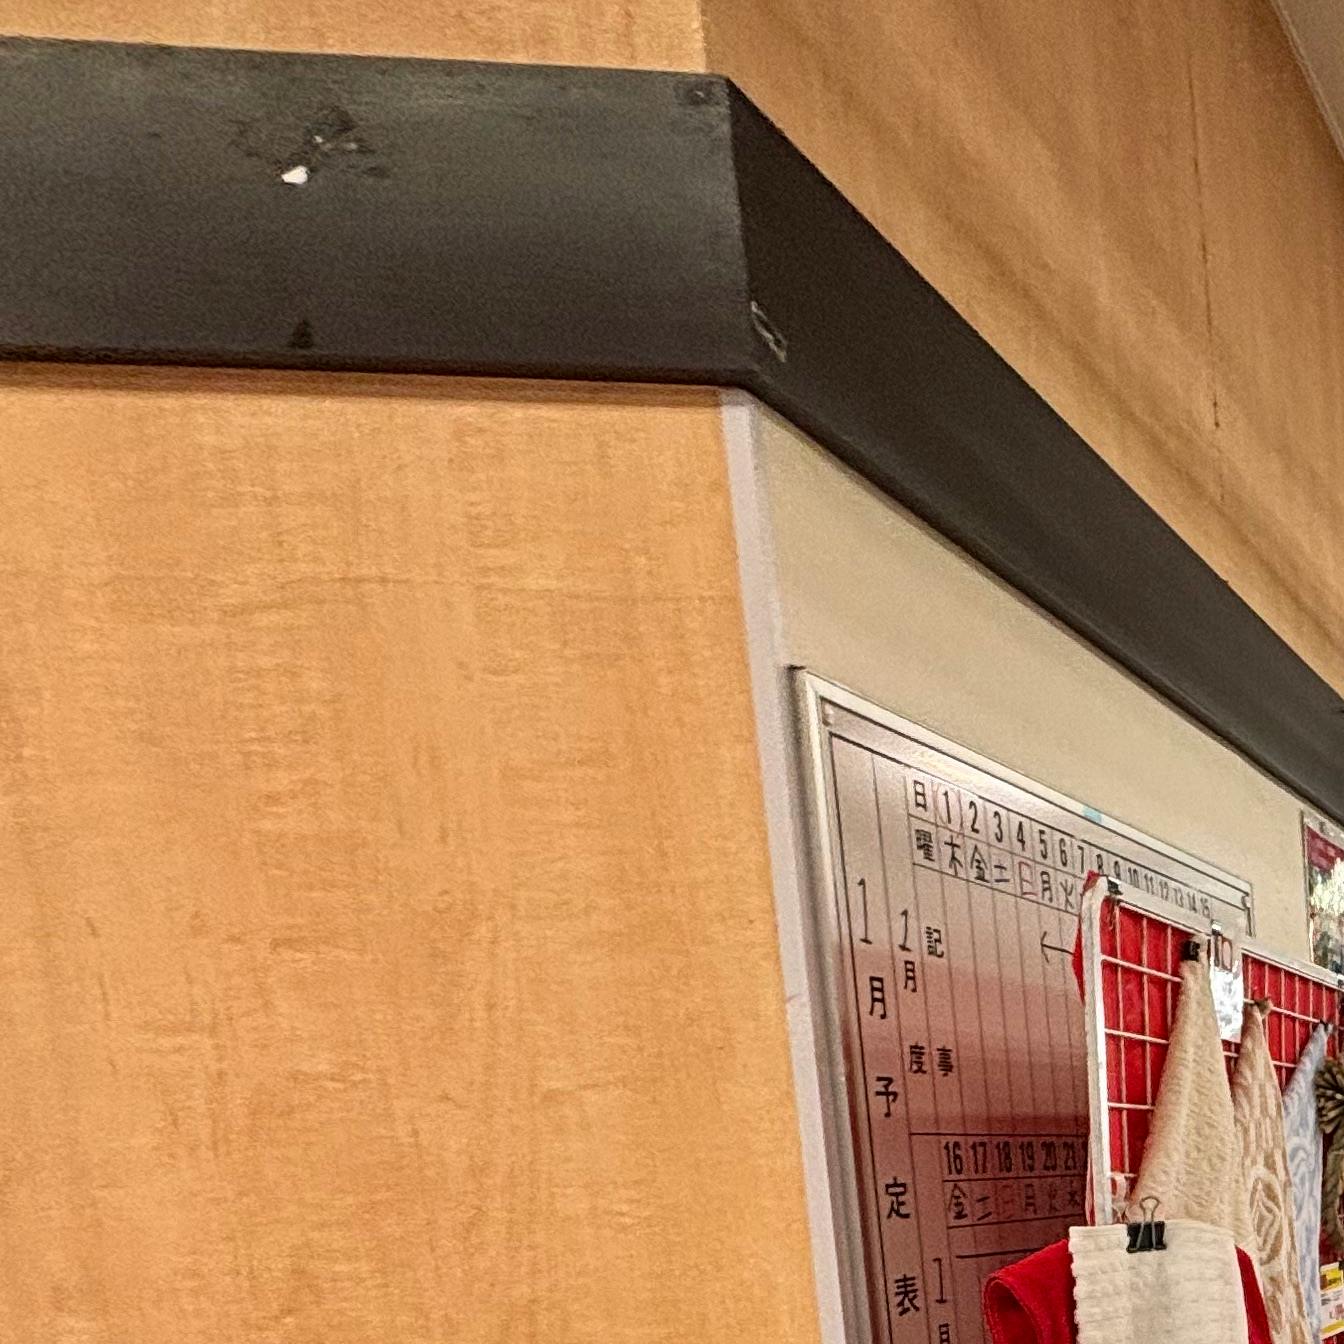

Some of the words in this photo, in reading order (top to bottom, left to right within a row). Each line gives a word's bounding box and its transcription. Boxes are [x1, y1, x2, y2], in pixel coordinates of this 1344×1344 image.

[913, 780, 927, 811] 日
[943, 790, 951, 824] 1
[969, 800, 980, 834] 2
[993, 811, 1003, 843] 3
[1017, 821, 1026, 851] 4
[1038, 829, 1048, 859] 5
[1060, 837, 1068, 867] 6
[1077, 845, 1086, 874] 7
[944, 1141, 963, 1175] 16
[969, 1141, 987, 1174] 17
[996, 1141, 1012, 1173] 18
[1019, 1141, 1035, 1172] 19
